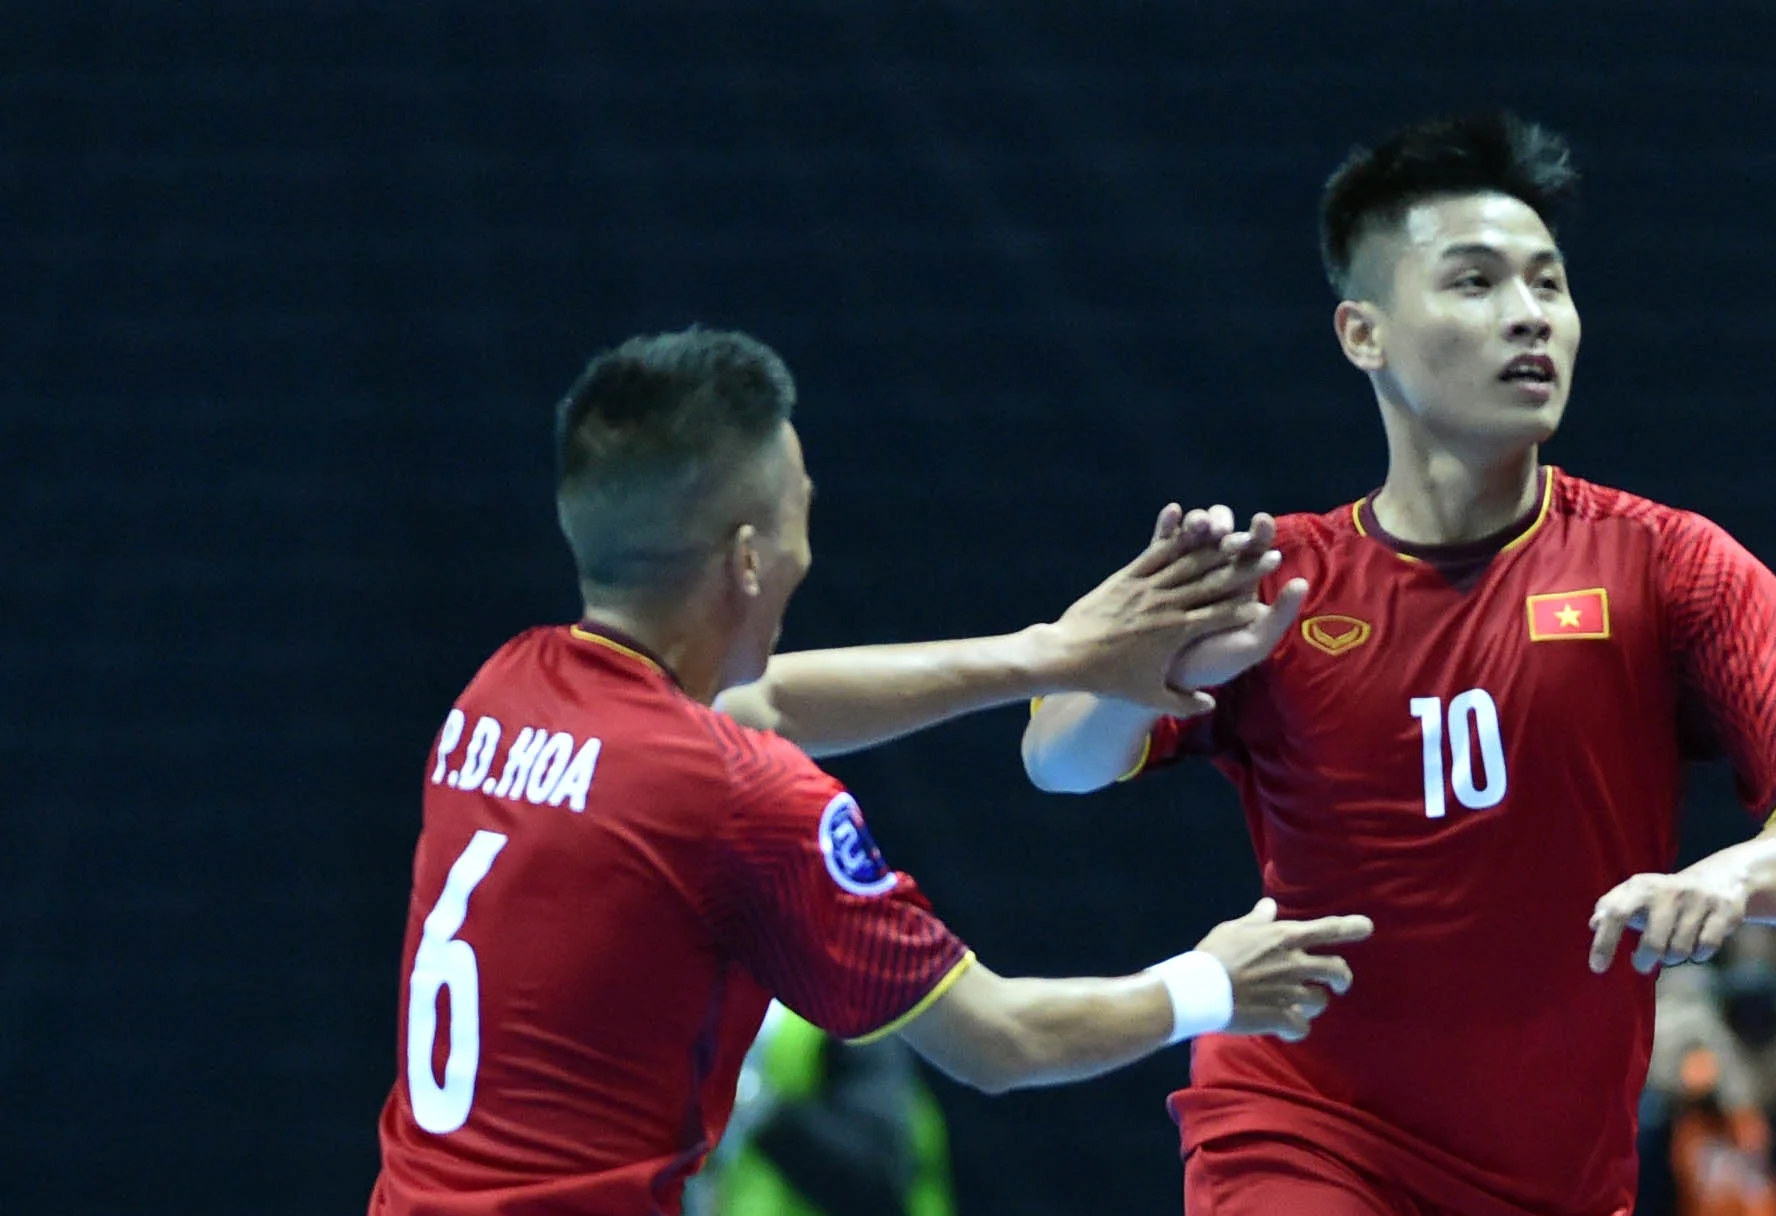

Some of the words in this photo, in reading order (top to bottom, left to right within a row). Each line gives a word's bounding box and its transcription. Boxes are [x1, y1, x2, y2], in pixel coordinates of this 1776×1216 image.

[431, 708, 602, 813] P.D.HOA
[1410, 688, 1507, 818] 10
[407, 830, 508, 1134] 6
